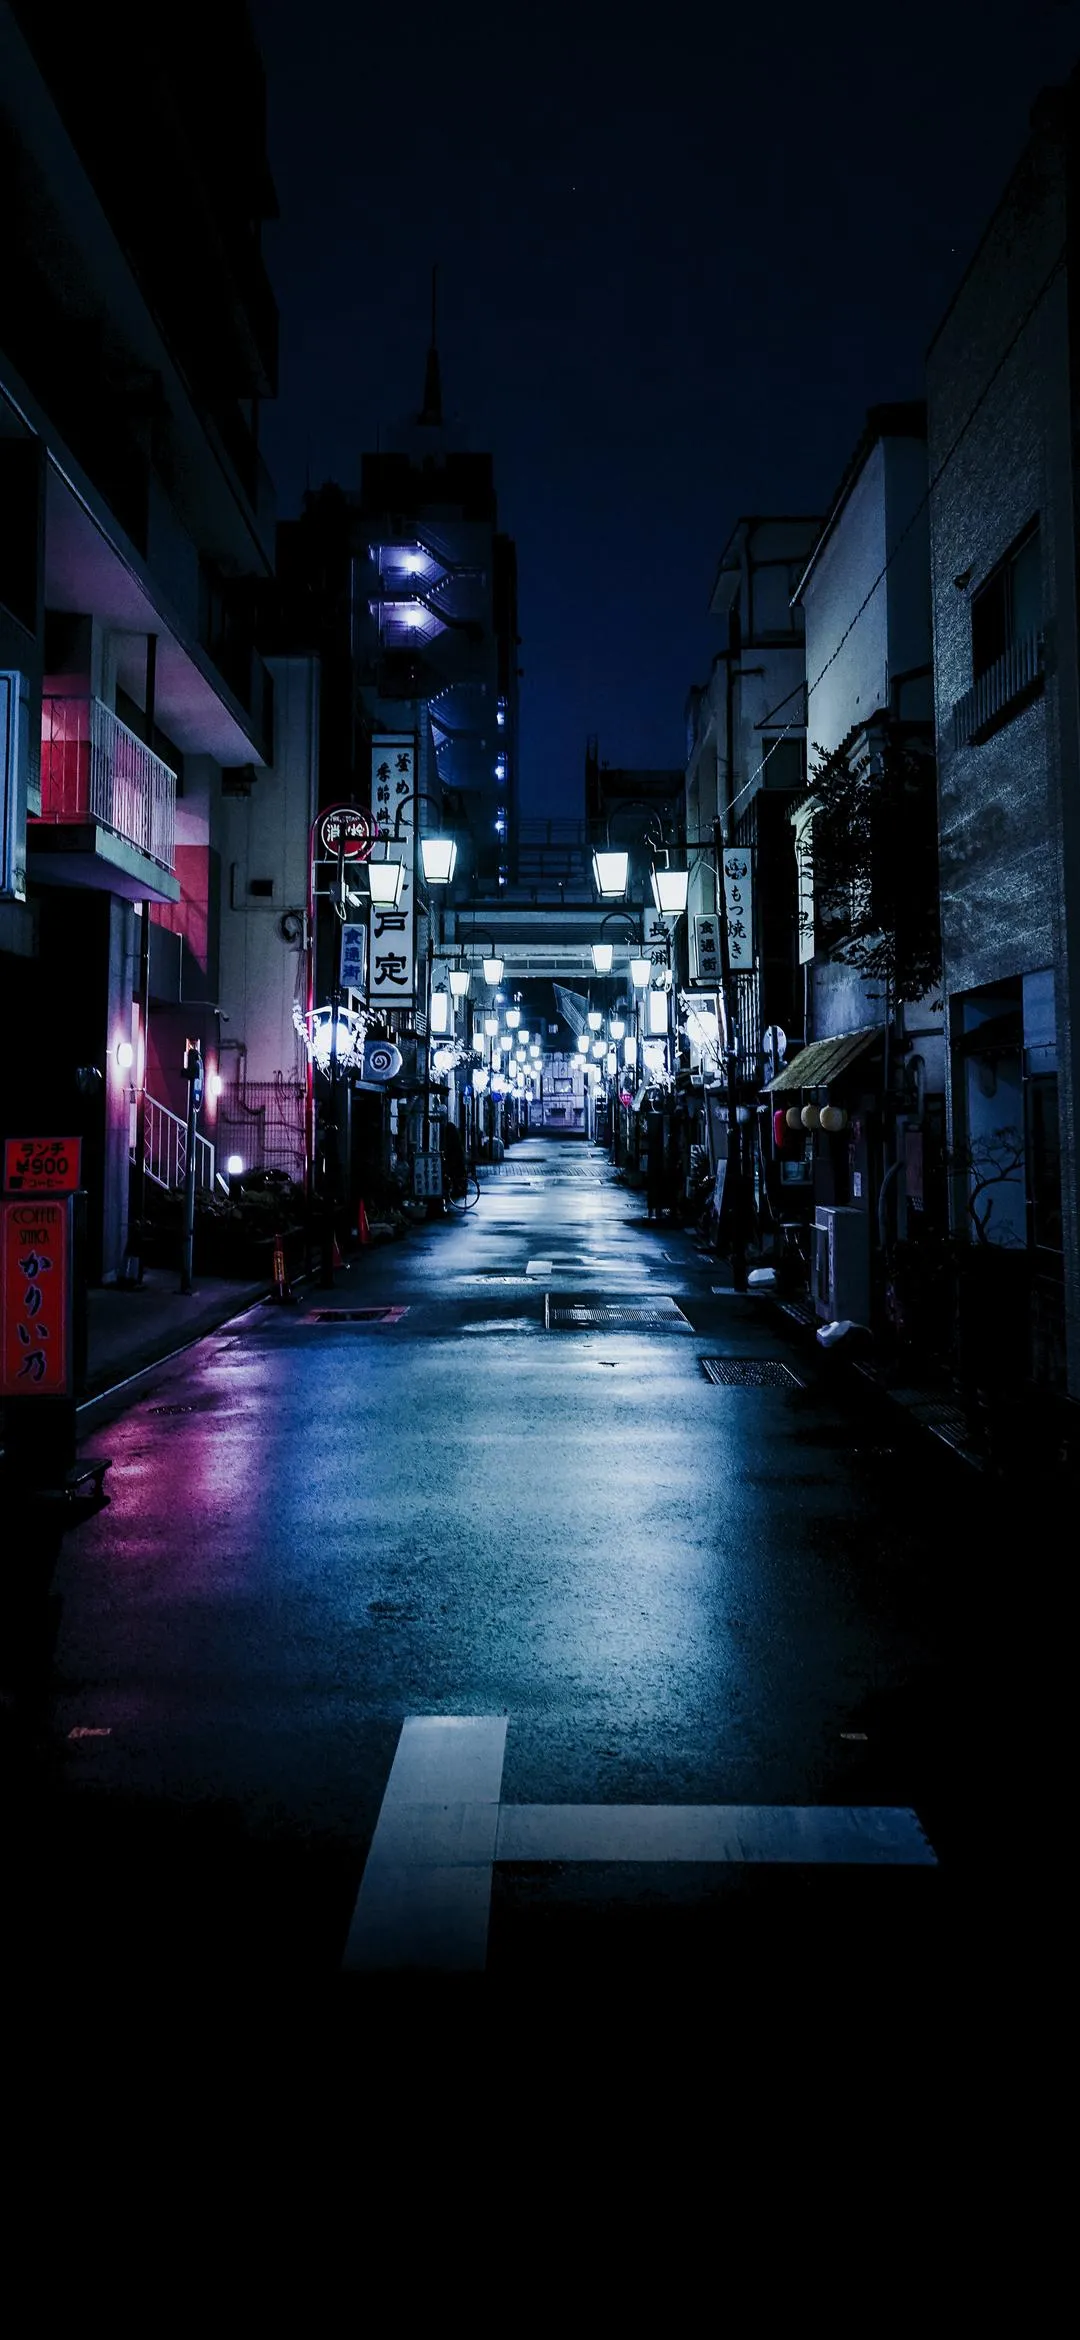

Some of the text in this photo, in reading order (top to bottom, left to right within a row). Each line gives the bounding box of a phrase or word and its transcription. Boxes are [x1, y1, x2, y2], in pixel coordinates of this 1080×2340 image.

[374, 884, 408, 985] 戸定
[728, 885, 747, 959] もつ焼き
[16, 1157, 68, 1175] ¥900
[20, 1142, 65, 1157] ランチ
[18, 1251, 52, 1381] かりい乃
